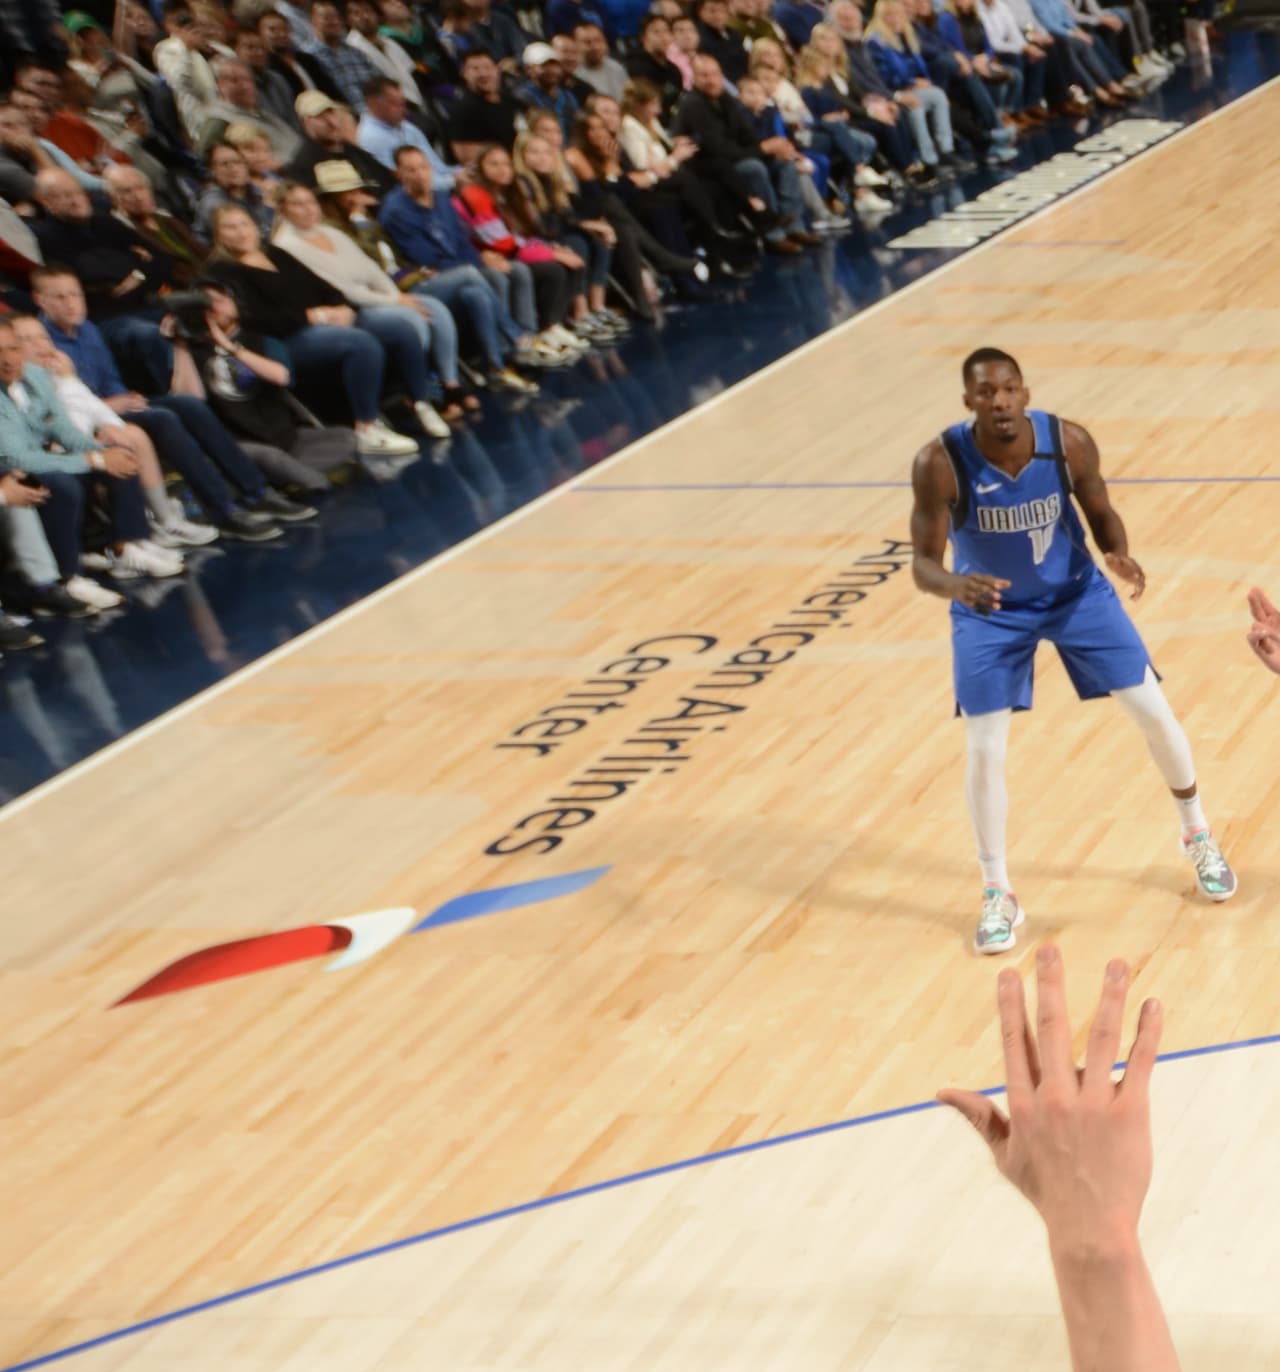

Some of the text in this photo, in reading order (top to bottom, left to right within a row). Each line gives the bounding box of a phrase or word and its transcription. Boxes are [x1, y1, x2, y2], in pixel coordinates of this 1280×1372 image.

[977, 491, 1060, 533] DALLAS
[483, 539, 915, 856] American Airlines
[495, 633, 719, 758] Center
